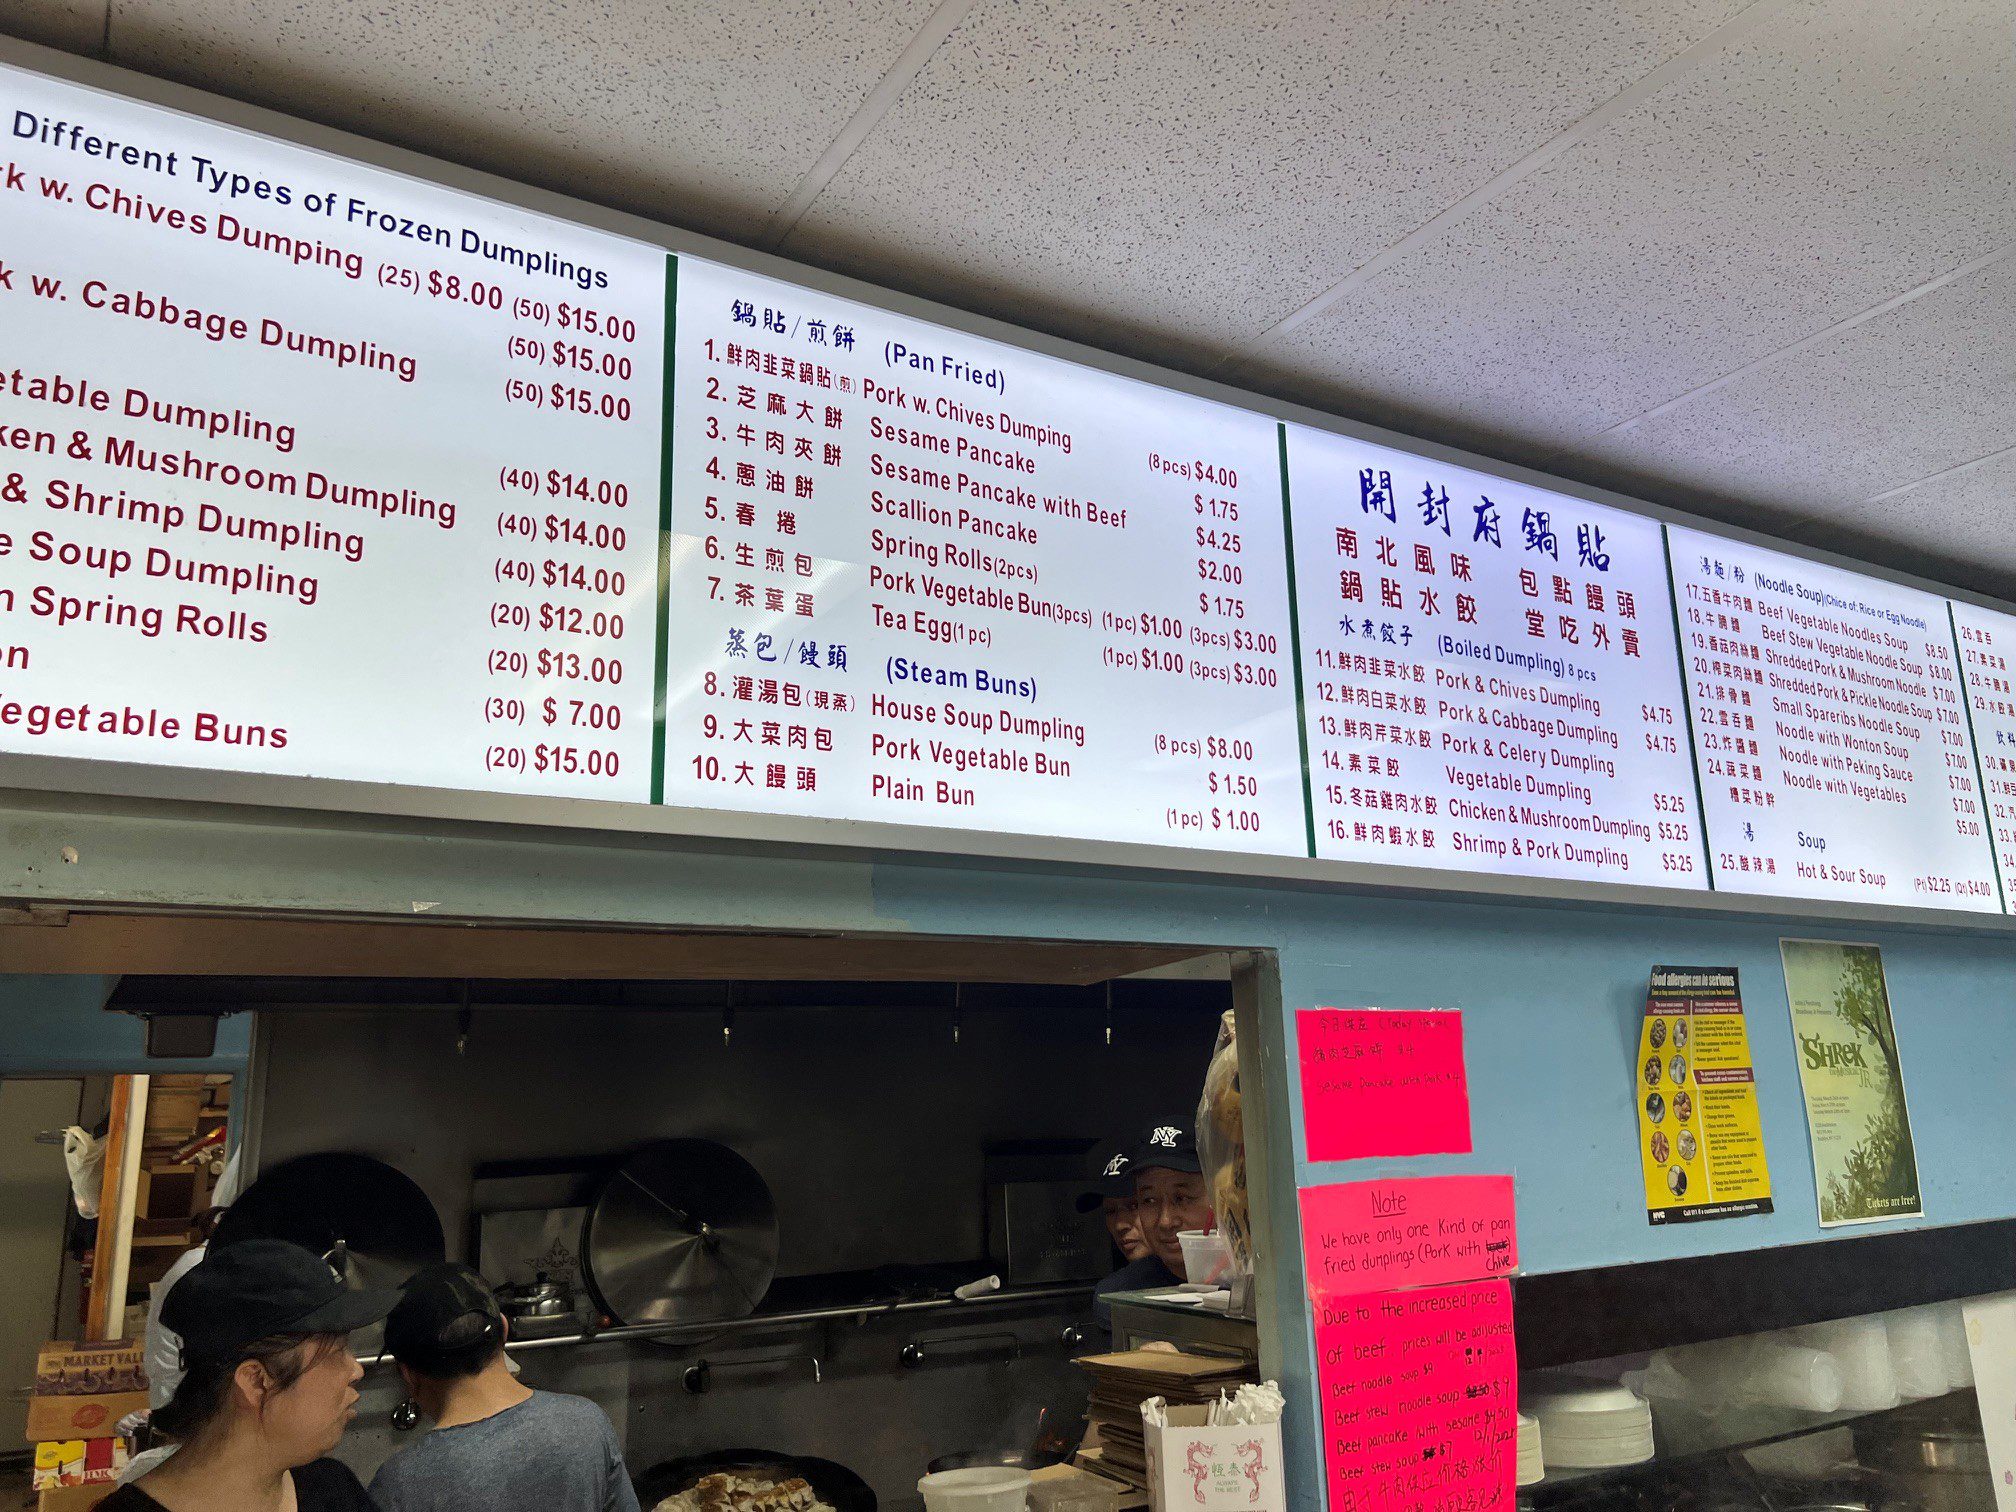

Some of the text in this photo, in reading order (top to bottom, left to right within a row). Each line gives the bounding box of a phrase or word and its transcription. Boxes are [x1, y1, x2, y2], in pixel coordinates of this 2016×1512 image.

[13, 110, 608, 290] Different Types of Frozen Dumplings
[39, 176, 73, 203] w.
[85, 183, 207, 235] Chives
[217, 214, 363, 280] Dumping
[428, 269, 503, 310] $8.00
[557, 302, 636, 343] $15.00
[31, 275, 66, 301] w.
[82, 280, 248, 342] Cabbage
[260, 318, 416, 383] Dumpling
[885, 341, 1005, 396] (Pan Fried)
[124, 388, 295, 453] Dumpling
[737, 385, 843, 430] 芝麻大餅
[863, 378, 1071, 454] Pork w. Chives Dumping
[736, 423, 841, 467] 牛肉夾餅
[870, 416, 1035, 474] Sesame Pancake
[104, 436, 456, 529] Mushroom Dumpling
[870, 453, 1126, 529] Sesame Pancake with Beef
[1195, 460, 1237, 489] $4.00
[45, 479, 364, 562] Shrimp Dumpling
[871, 490, 1037, 544] Scallion Pancake
[735, 542, 813, 578] 生煎包
[871, 528, 938, 568] Spring
[1335, 527, 1473, 582] 南北風味
[29, 531, 318, 606] Soup Dumpling
[1754, 572, 1794, 596] (Noodle
[870, 565, 1014, 611] Pork Vegetable
[1339, 570, 1478, 625] 鍋貼水餃
[1519, 567, 1636, 620] 包點饅頭
[30, 586, 267, 643] Spring Rolls
[872, 603, 907, 631] Tea
[1339, 614, 1413, 647] 水煮餃子
[1758, 601, 1908, 654] Beef Vegetable Noodles Soup
[1525, 607, 1640, 658] 堂吃外賣
[1338, 651, 1425, 683] 鮮肉韭菜水餃
[1438, 634, 1565, 679] (Boiled Dumpling)
[1789, 631, 1898, 670] Stew Noodle
[1925, 643, 1948, 660] $8.50
[886, 656, 1036, 704] (Steam Buns)
[1765, 648, 1895, 690] Shredded Pork Mushroom
[1341, 684, 1427, 716] 鮮肉白菜水餃
[1436, 668, 1600, 717] Pork Chives Dumpling
[1849, 689, 1877, 709] Pickle
[1932, 686, 1955, 704] $7.00
[872, 693, 1084, 747] House Soup Dumpling
[1492, 709, 1554, 738] Cabbage
[1641, 704, 1672, 725] $4.75
[1772, 696, 1856, 727] Small Spareribs
[194, 712, 287, 749] Buns
[1207, 735, 1253, 761] $8.00
[1817, 730, 1882, 754] with Wonton
[872, 733, 1070, 777] Pork Vegetable Bun
[1348, 753, 1400, 777] 素菜餃
[1498, 741, 1546, 769] Celery
[1846, 757, 1913, 782] Peking Sauce
[734, 760, 816, 792] 大饅頭
[872, 774, 974, 806] Plain Bun
[1445, 765, 1522, 792] Vegetable
[1849, 781, 1907, 803] Vegetables
[1449, 798, 1591, 832] Chicken Mushroom
[1653, 793, 1685, 813] $5.25
[1452, 831, 1506, 859] Shrimp
[1796, 861, 1855, 882] Hot Sour
[1150, 1126, 1183, 1147] NY
[1371, 1190, 1407, 1214] Note
[1342, 1227, 1370, 1245] have
[1377, 1224, 1401, 1243] only
[1407, 1223, 1429, 1236] one
[1490, 1219, 1510, 1234] pan
[1324, 1290, 1498, 1325] Due to the increased price
[64, 1354, 115, 1366] MARKET
[1403, 1335, 1431, 1358] prices
